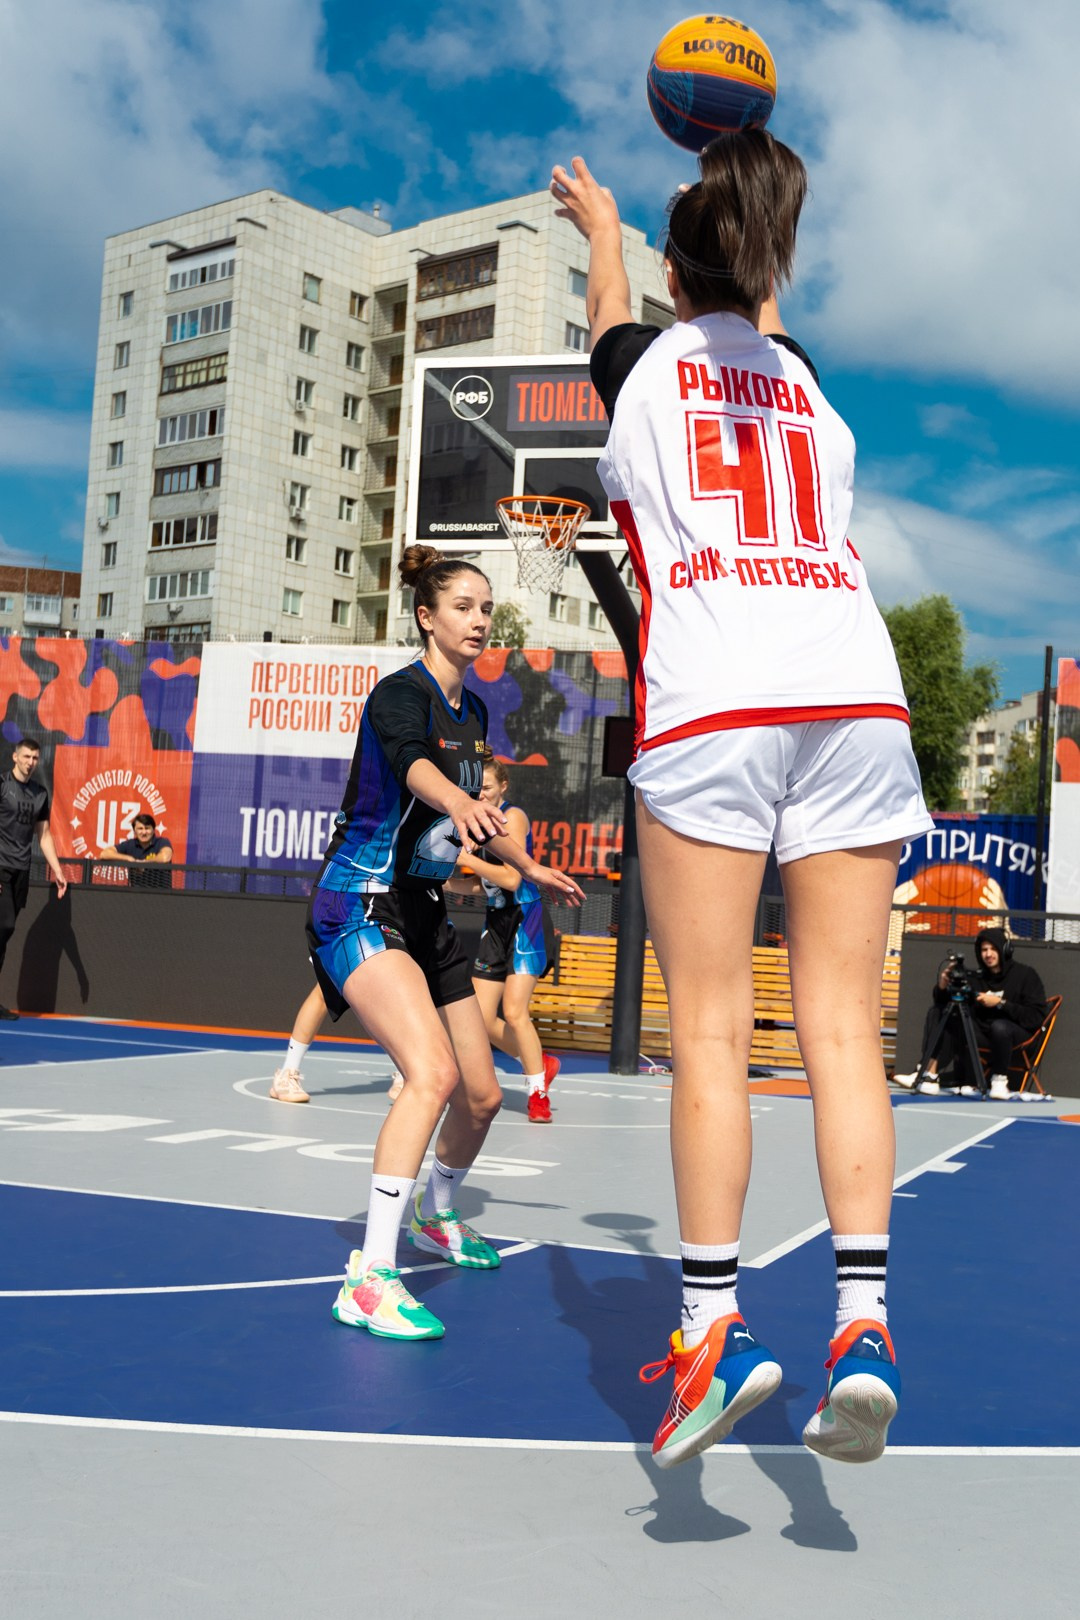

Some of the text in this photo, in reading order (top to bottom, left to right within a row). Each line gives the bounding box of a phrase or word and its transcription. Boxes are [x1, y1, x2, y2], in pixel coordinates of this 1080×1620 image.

[683, 39, 767, 80] Wilson
[455, 391, 488, 404] РФБ
[677, 360, 815, 418] РЫКОВА
[685, 411, 829, 551] 41
[429, 522, 499, 532] @RUSSIABASKET
[251, 661, 379, 697] ПЕРВЕНСТВО
[248, 698, 332, 733] РОССИИ
[72, 769, 167, 816] ПЕРВЕНСТВО РОССИИ
